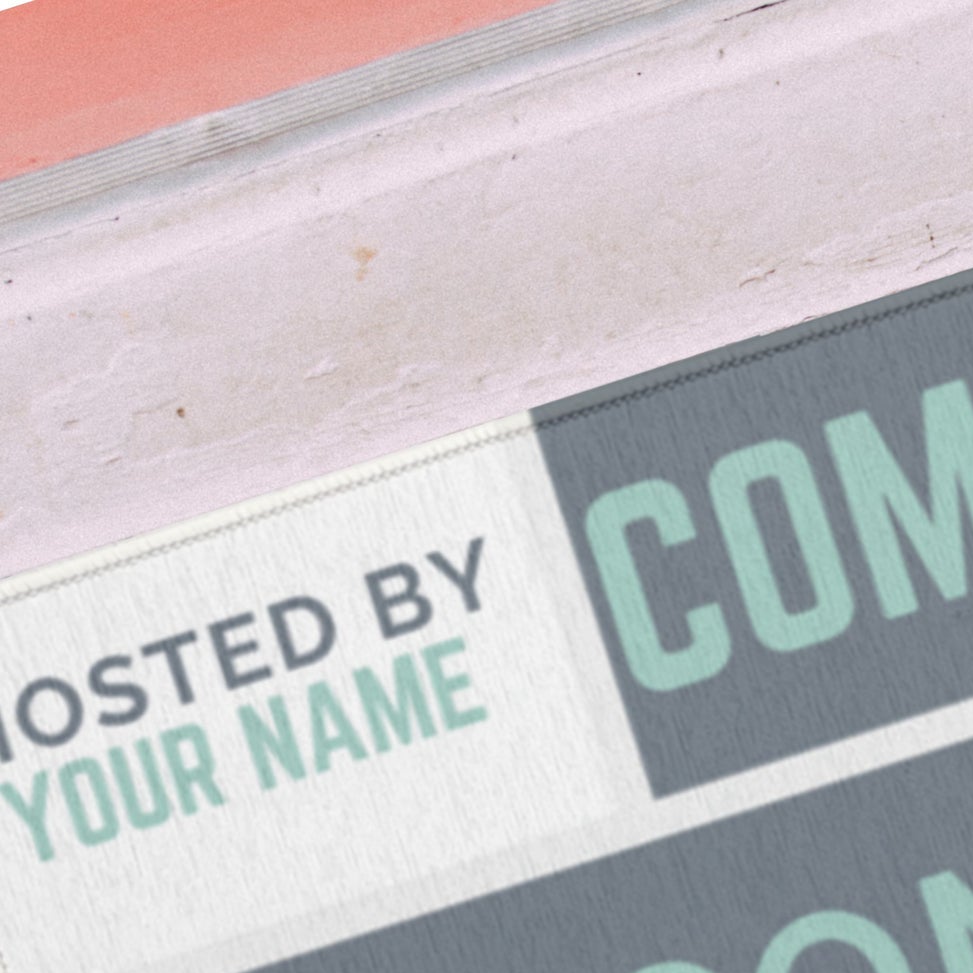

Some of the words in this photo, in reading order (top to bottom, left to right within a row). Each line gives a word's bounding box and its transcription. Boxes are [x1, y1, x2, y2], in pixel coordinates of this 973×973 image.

[364, 536, 485, 640] BY
[0, 723, 226, 862] YOUR
[237, 635, 488, 791] NAME
